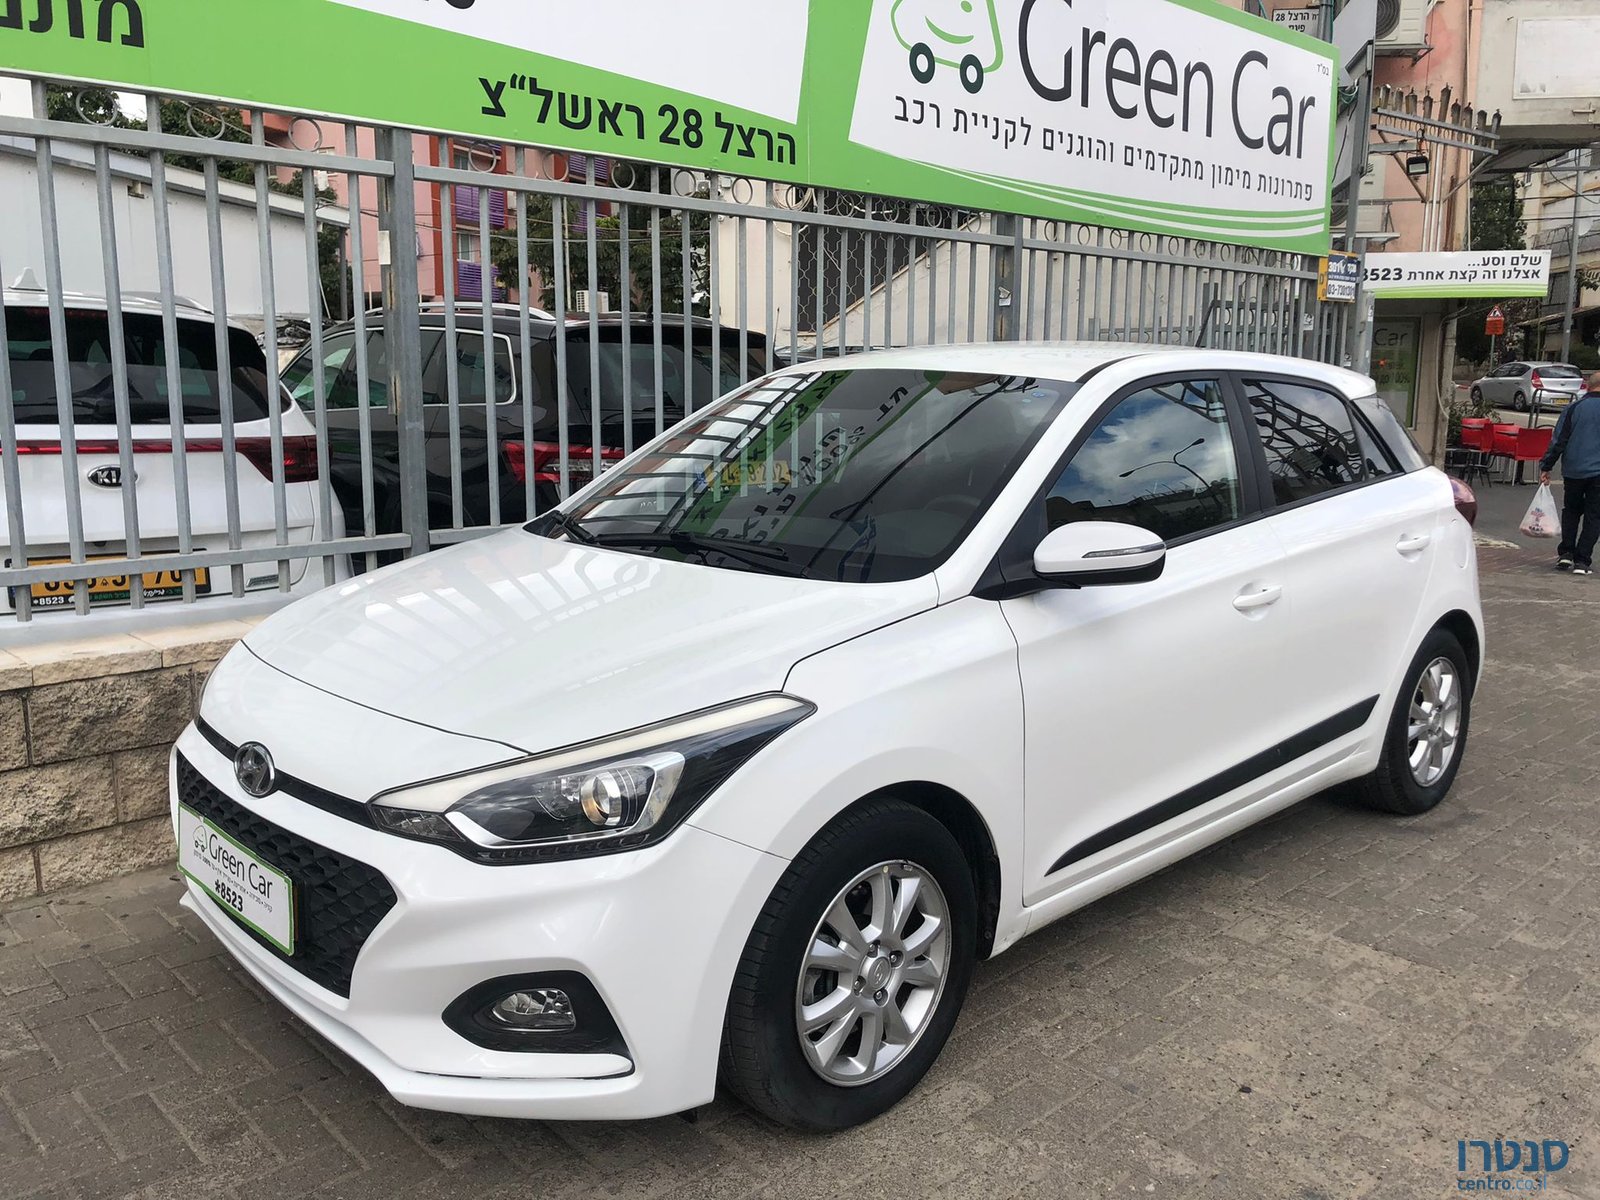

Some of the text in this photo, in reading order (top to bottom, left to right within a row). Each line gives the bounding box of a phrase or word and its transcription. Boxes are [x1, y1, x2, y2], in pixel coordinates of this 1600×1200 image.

[1275, 12, 1286, 22] 28
[1287, 10, 1310, 21] הרצל
[1018, 0, 1316, 159] Green Car
[478, 72, 797, 166] הרצל 28 ראשל"צ
[894, 95, 1313, 201] פתרונות מימון מתקדמים והוגנים לקניית רכב
[1468, 253, 1542, 267] שלם וסע...
[1407, 270, 1445, 281] אחרת
[1448, 269, 1478, 283] קצת
[1482, 269, 1498, 280] זה
[1502, 267, 1541, 280] אצלנו
[1374, 327, 1408, 346] Car
[97, 469, 121, 484] KI
[208, 833, 245, 881] Green
[248, 862, 274, 899] Car
